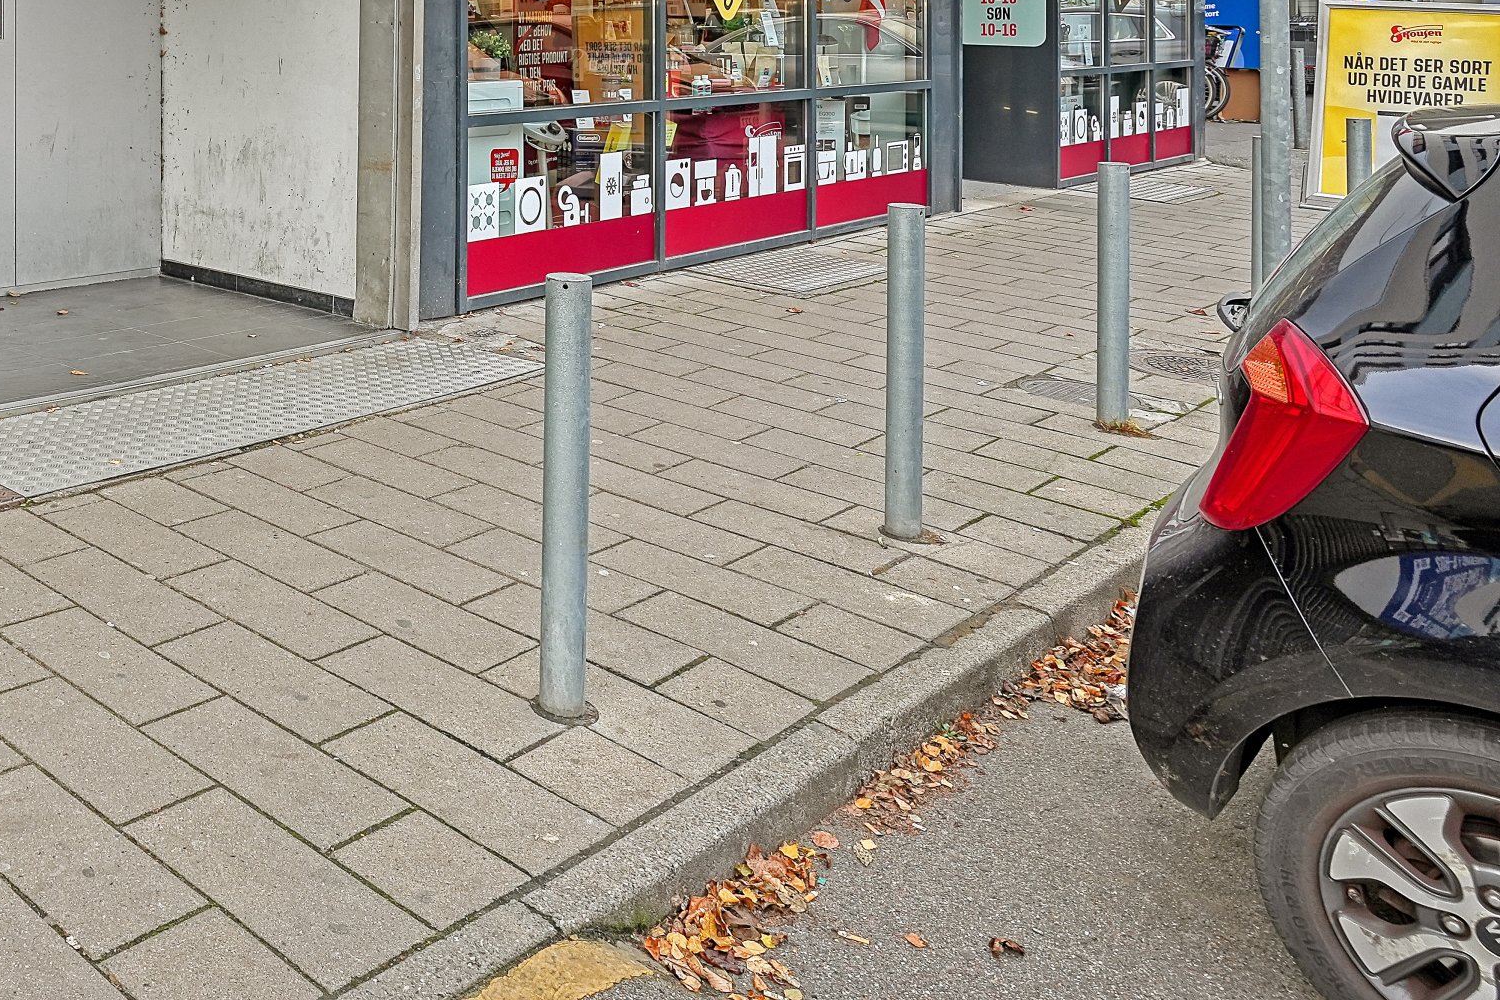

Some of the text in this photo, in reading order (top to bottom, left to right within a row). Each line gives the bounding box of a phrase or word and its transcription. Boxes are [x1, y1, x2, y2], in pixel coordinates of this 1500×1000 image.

[986, 7, 1011, 20] SØN
[980, 23, 1017, 36] 10-16
[532, 39, 543, 50] DET
[519, 51, 568, 65] RIGTIGE PRODUKT
[1344, 52, 1492, 76] NÅR DET SER SORT
[530, 66, 541, 78] DEN
[1348, 72, 1487, 92] UD FOR DE GAMLE
[1367, 89, 1464, 106] HVIDEVARER
